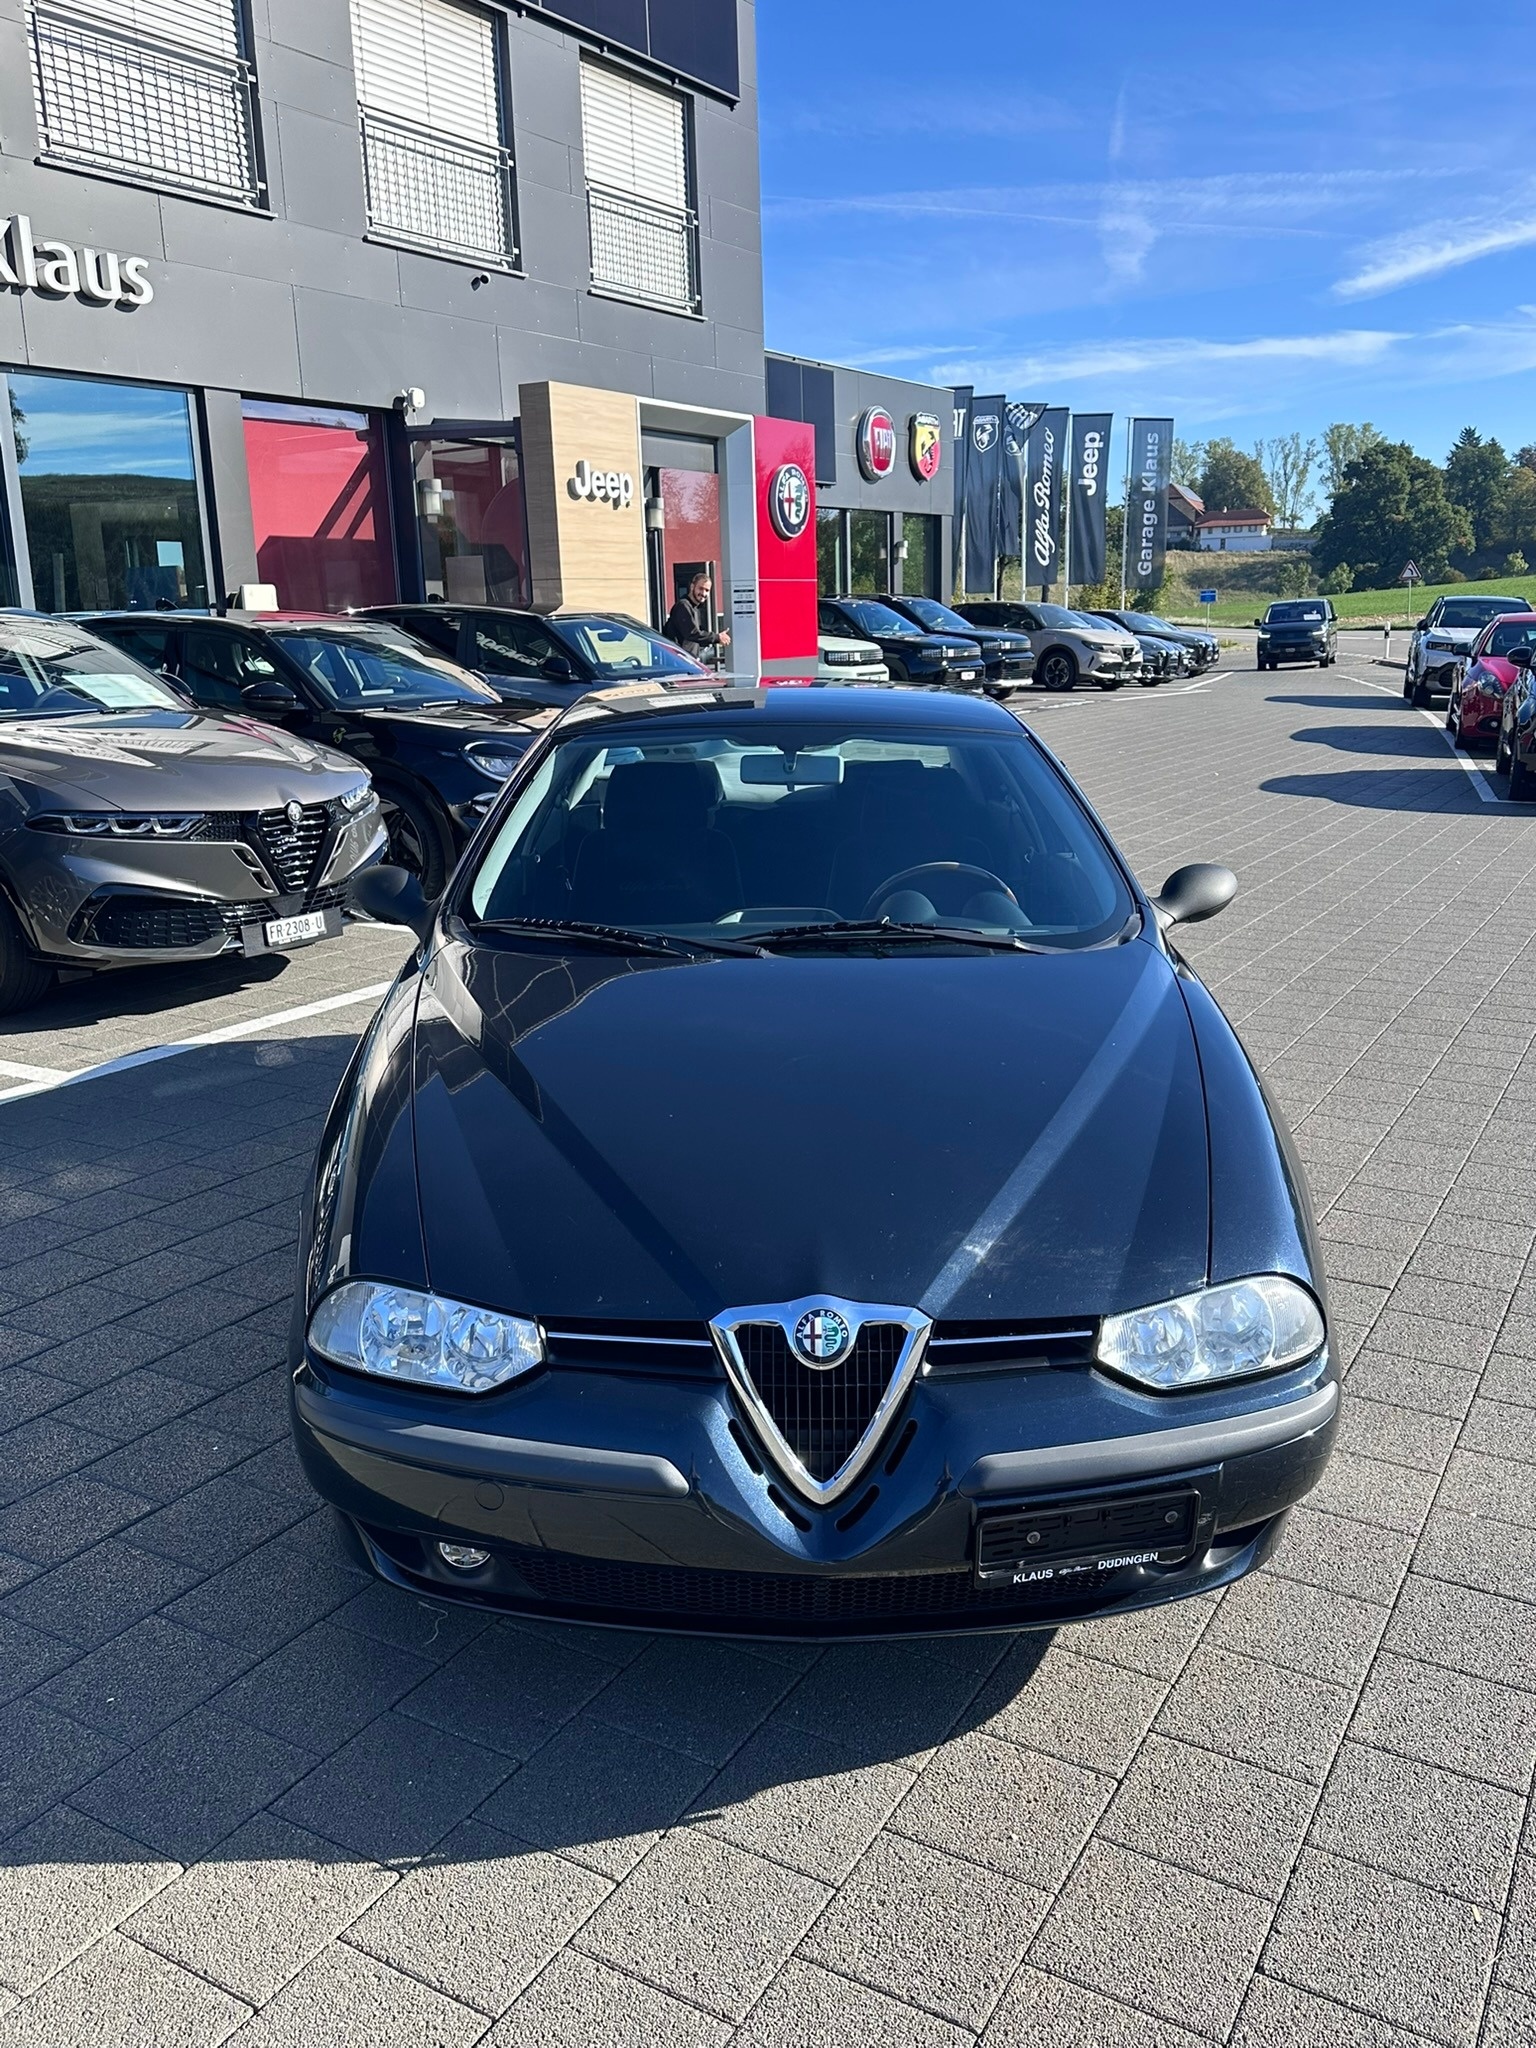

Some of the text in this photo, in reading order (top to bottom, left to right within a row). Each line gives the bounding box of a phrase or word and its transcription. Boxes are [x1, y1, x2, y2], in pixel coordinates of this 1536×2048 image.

[571, 460, 634, 507] Jeep
[1078, 431, 1104, 496] Jeep
[1034, 426, 1055, 567] Alfa Romeo
[1138, 432, 1159, 576] Garage Klaus
[796, 1310, 848, 1339] ALFA ROMEO
[1013, 1569, 1054, 1584] KLAUS
